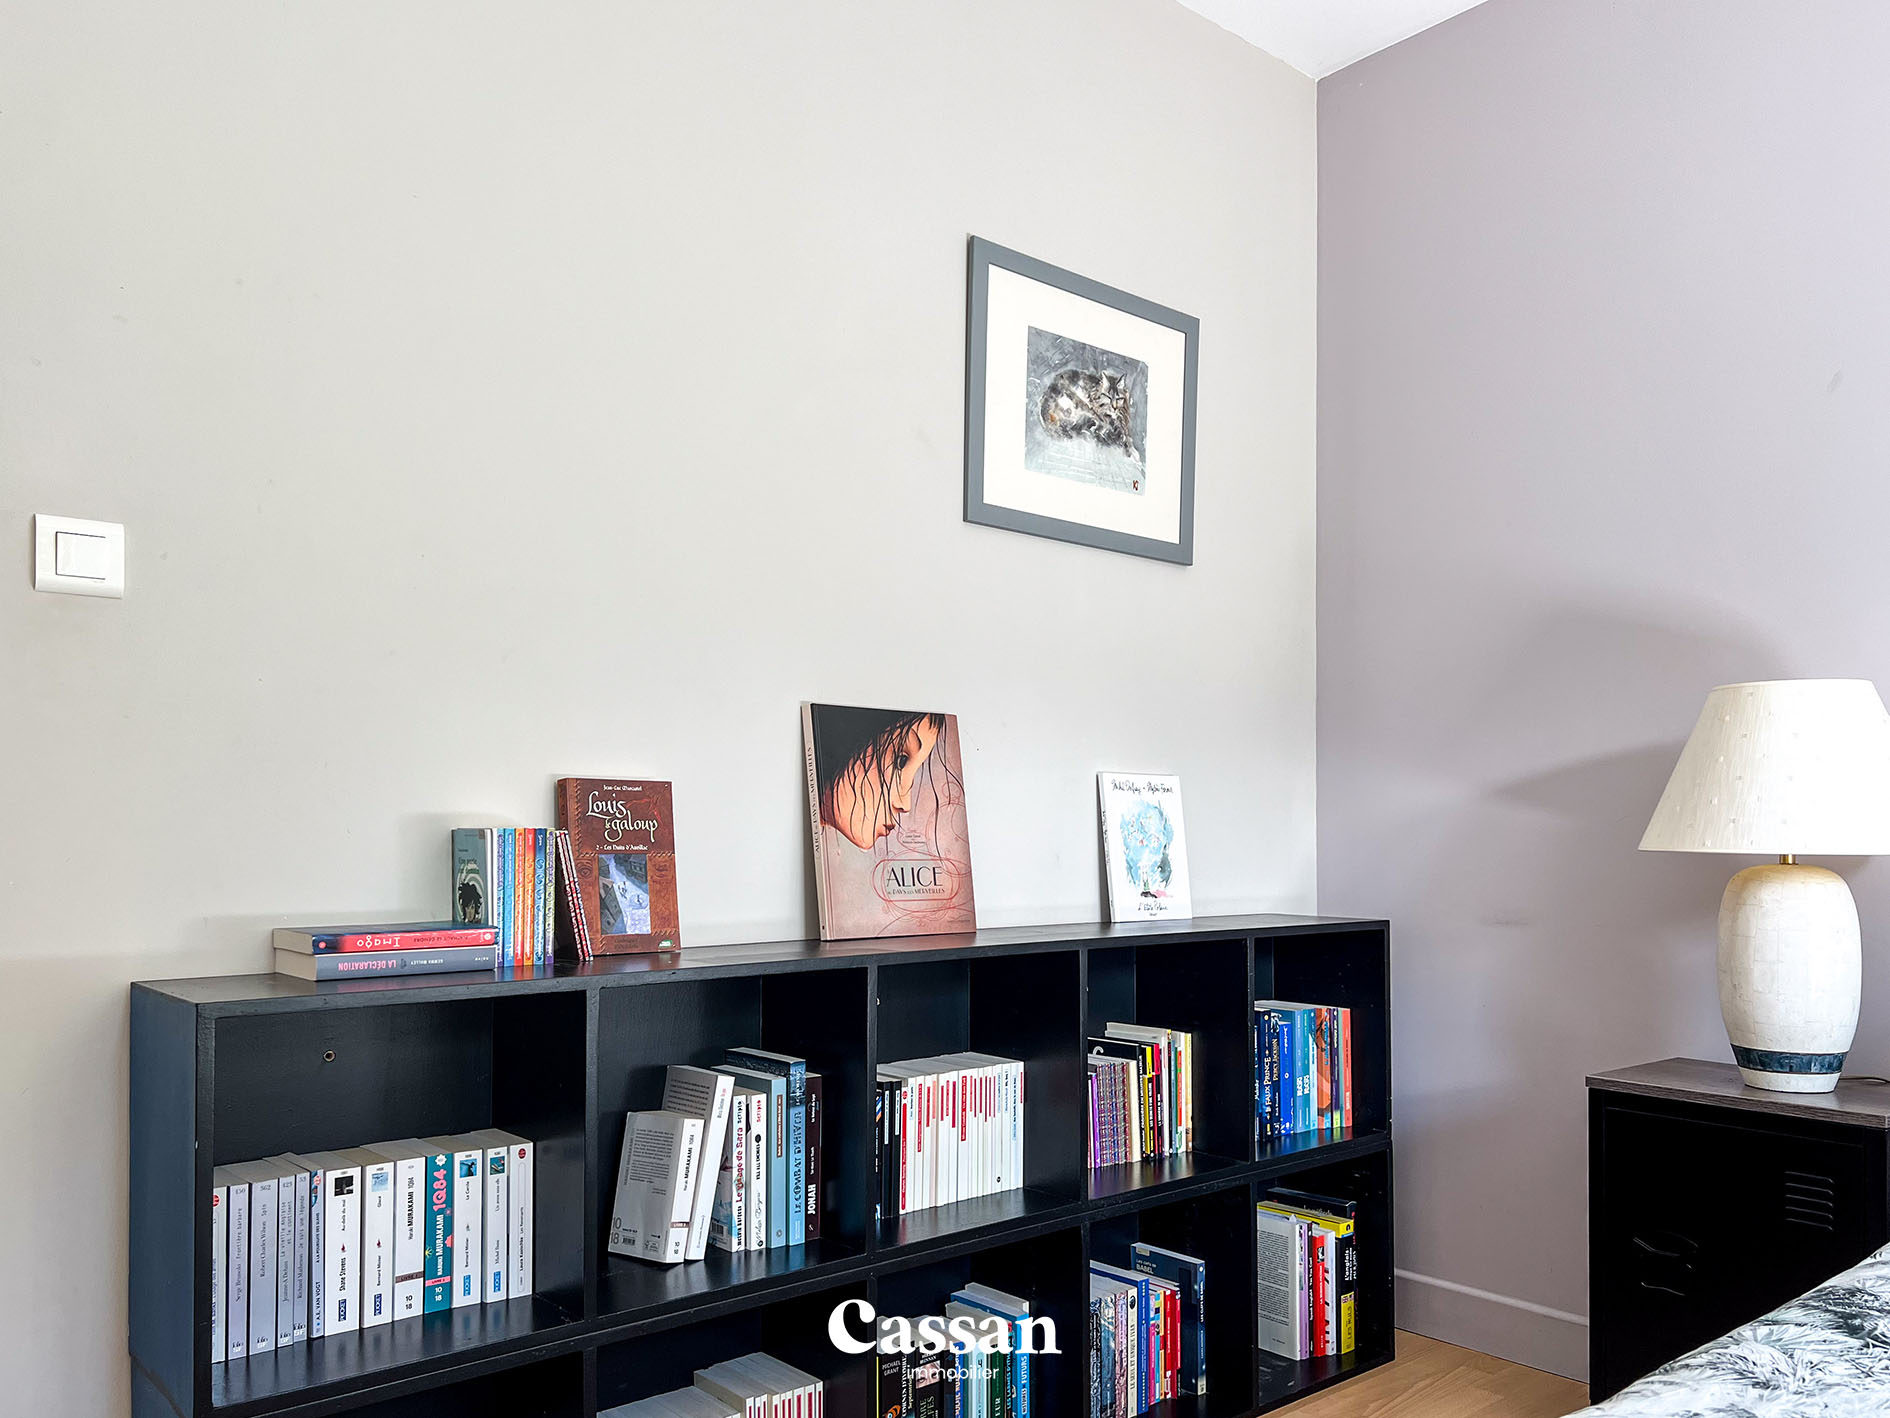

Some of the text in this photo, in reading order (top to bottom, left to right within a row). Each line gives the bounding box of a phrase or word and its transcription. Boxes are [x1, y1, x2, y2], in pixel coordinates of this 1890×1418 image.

[586, 791, 627, 818] Louis
[605, 810, 658, 843] galoup
[887, 866, 943, 887] ALICE
[356, 934, 401, 949] Imago
[338, 960, 387, 971] DÉCLARATION
[387, 959, 397, 969] LA
[794, 1111, 802, 1154] D'HIVER
[684, 1147, 693, 1179] MURAKAMI
[736, 1150, 743, 1160] de
[794, 1157, 802, 1201] COMBAT
[433, 1169, 447, 1212] 1Q84
[736, 1192, 743, 1202] Le
[808, 1184, 816, 1215] JONAH
[613, 1217, 622, 1229] 10
[436, 1214, 444, 1255] MURAKAMI
[610, 1232, 620, 1244] 18
[339, 1258, 347, 1276] Stevens
[1136, 1264, 1154, 1274] BABEL
[338, 1299, 346, 1322] POCKET
[374, 1293, 382, 1316] POCKET
[882, 1360, 901, 1370] MICHAEL
[884, 1367, 899, 1376] GRANT
